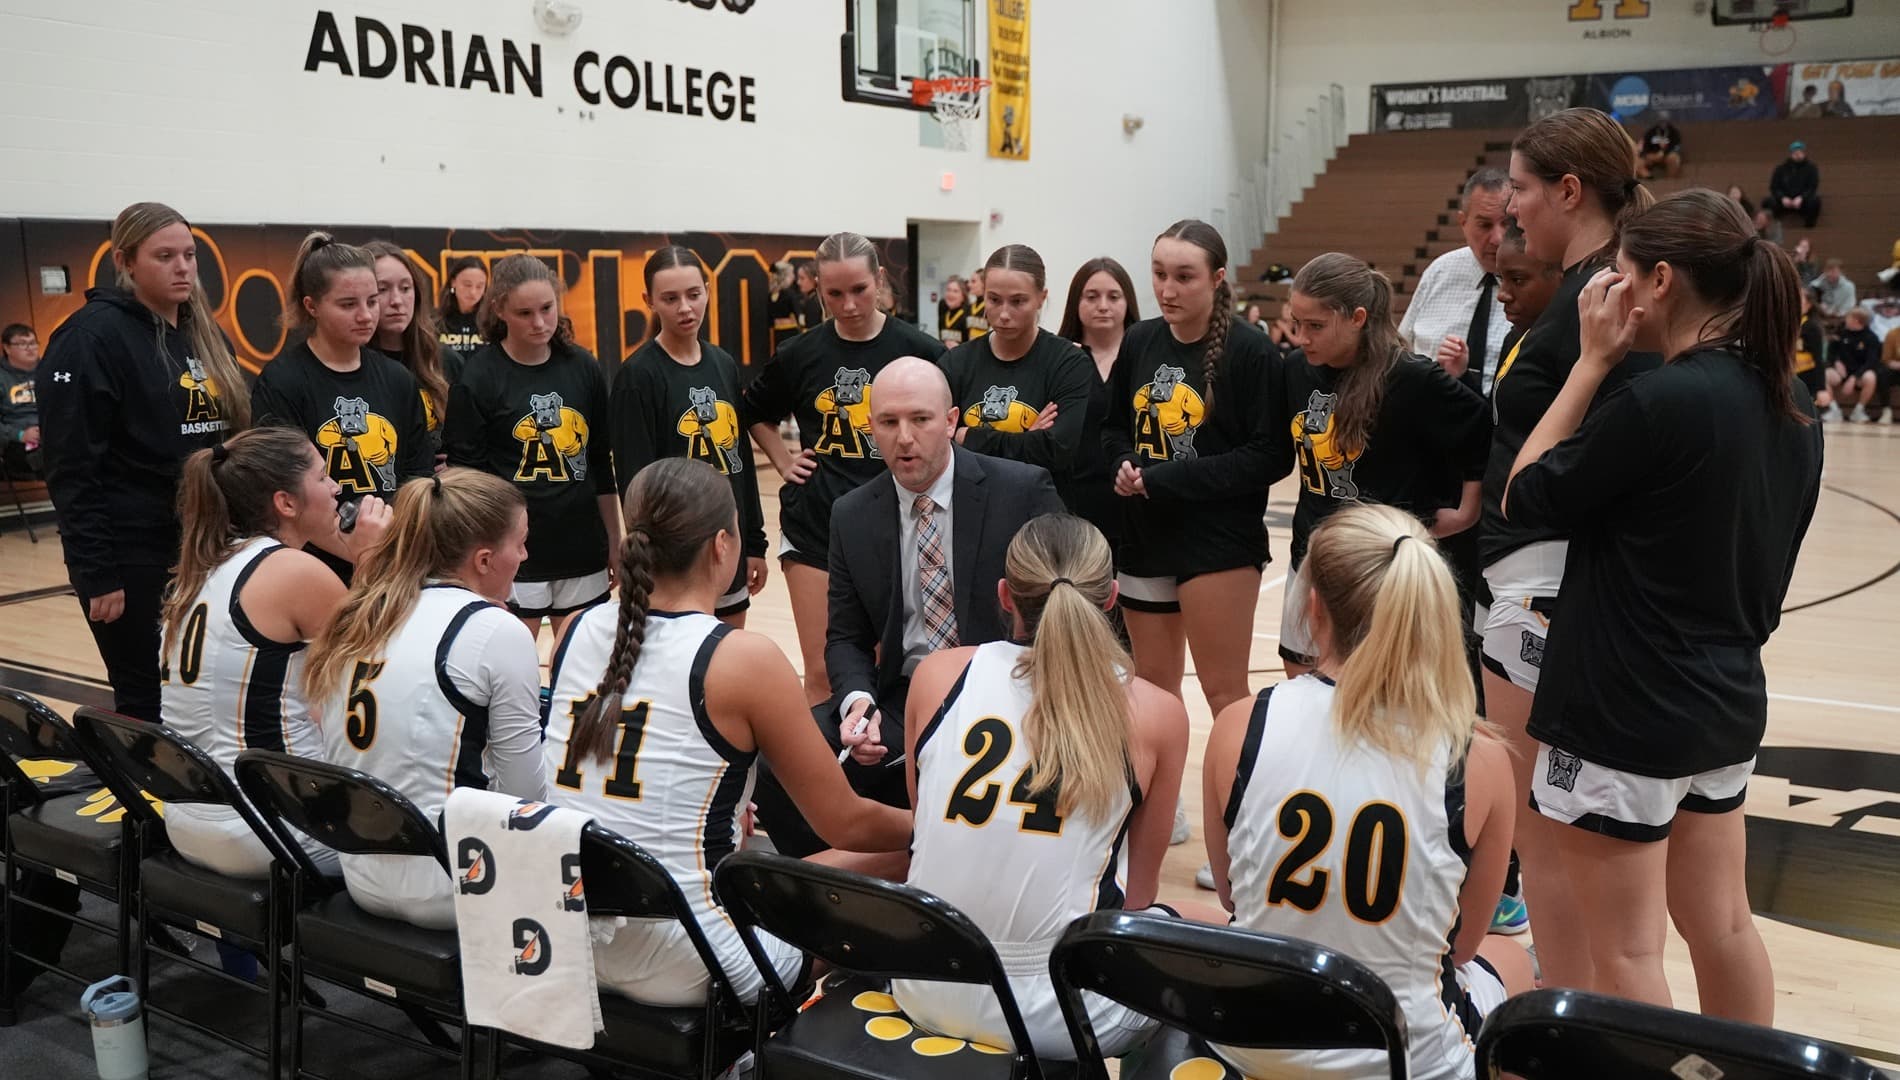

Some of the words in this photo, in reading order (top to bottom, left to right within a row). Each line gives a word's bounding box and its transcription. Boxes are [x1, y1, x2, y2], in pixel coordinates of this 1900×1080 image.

[1583, 28, 1631, 40] ALBION
[303, 10, 544, 98] ADRIAN
[573, 50, 757, 123] COLLEGE
[1386, 87, 1440, 105] WOMEN'S
[1440, 85, 1507, 103] BASKETBALL
[1613, 94, 1649, 107] NCAA
[439, 333, 488, 345] ADRIA
[814, 411, 864, 459] A
[1135, 407, 1169, 460] A
[325, 444, 377, 493] A
[513, 437, 570, 482] A
[346, 659, 387, 752] 5
[556, 691, 652, 803] 11
[943, 715, 1066, 838] 24
[1266, 788, 1411, 926] 20
